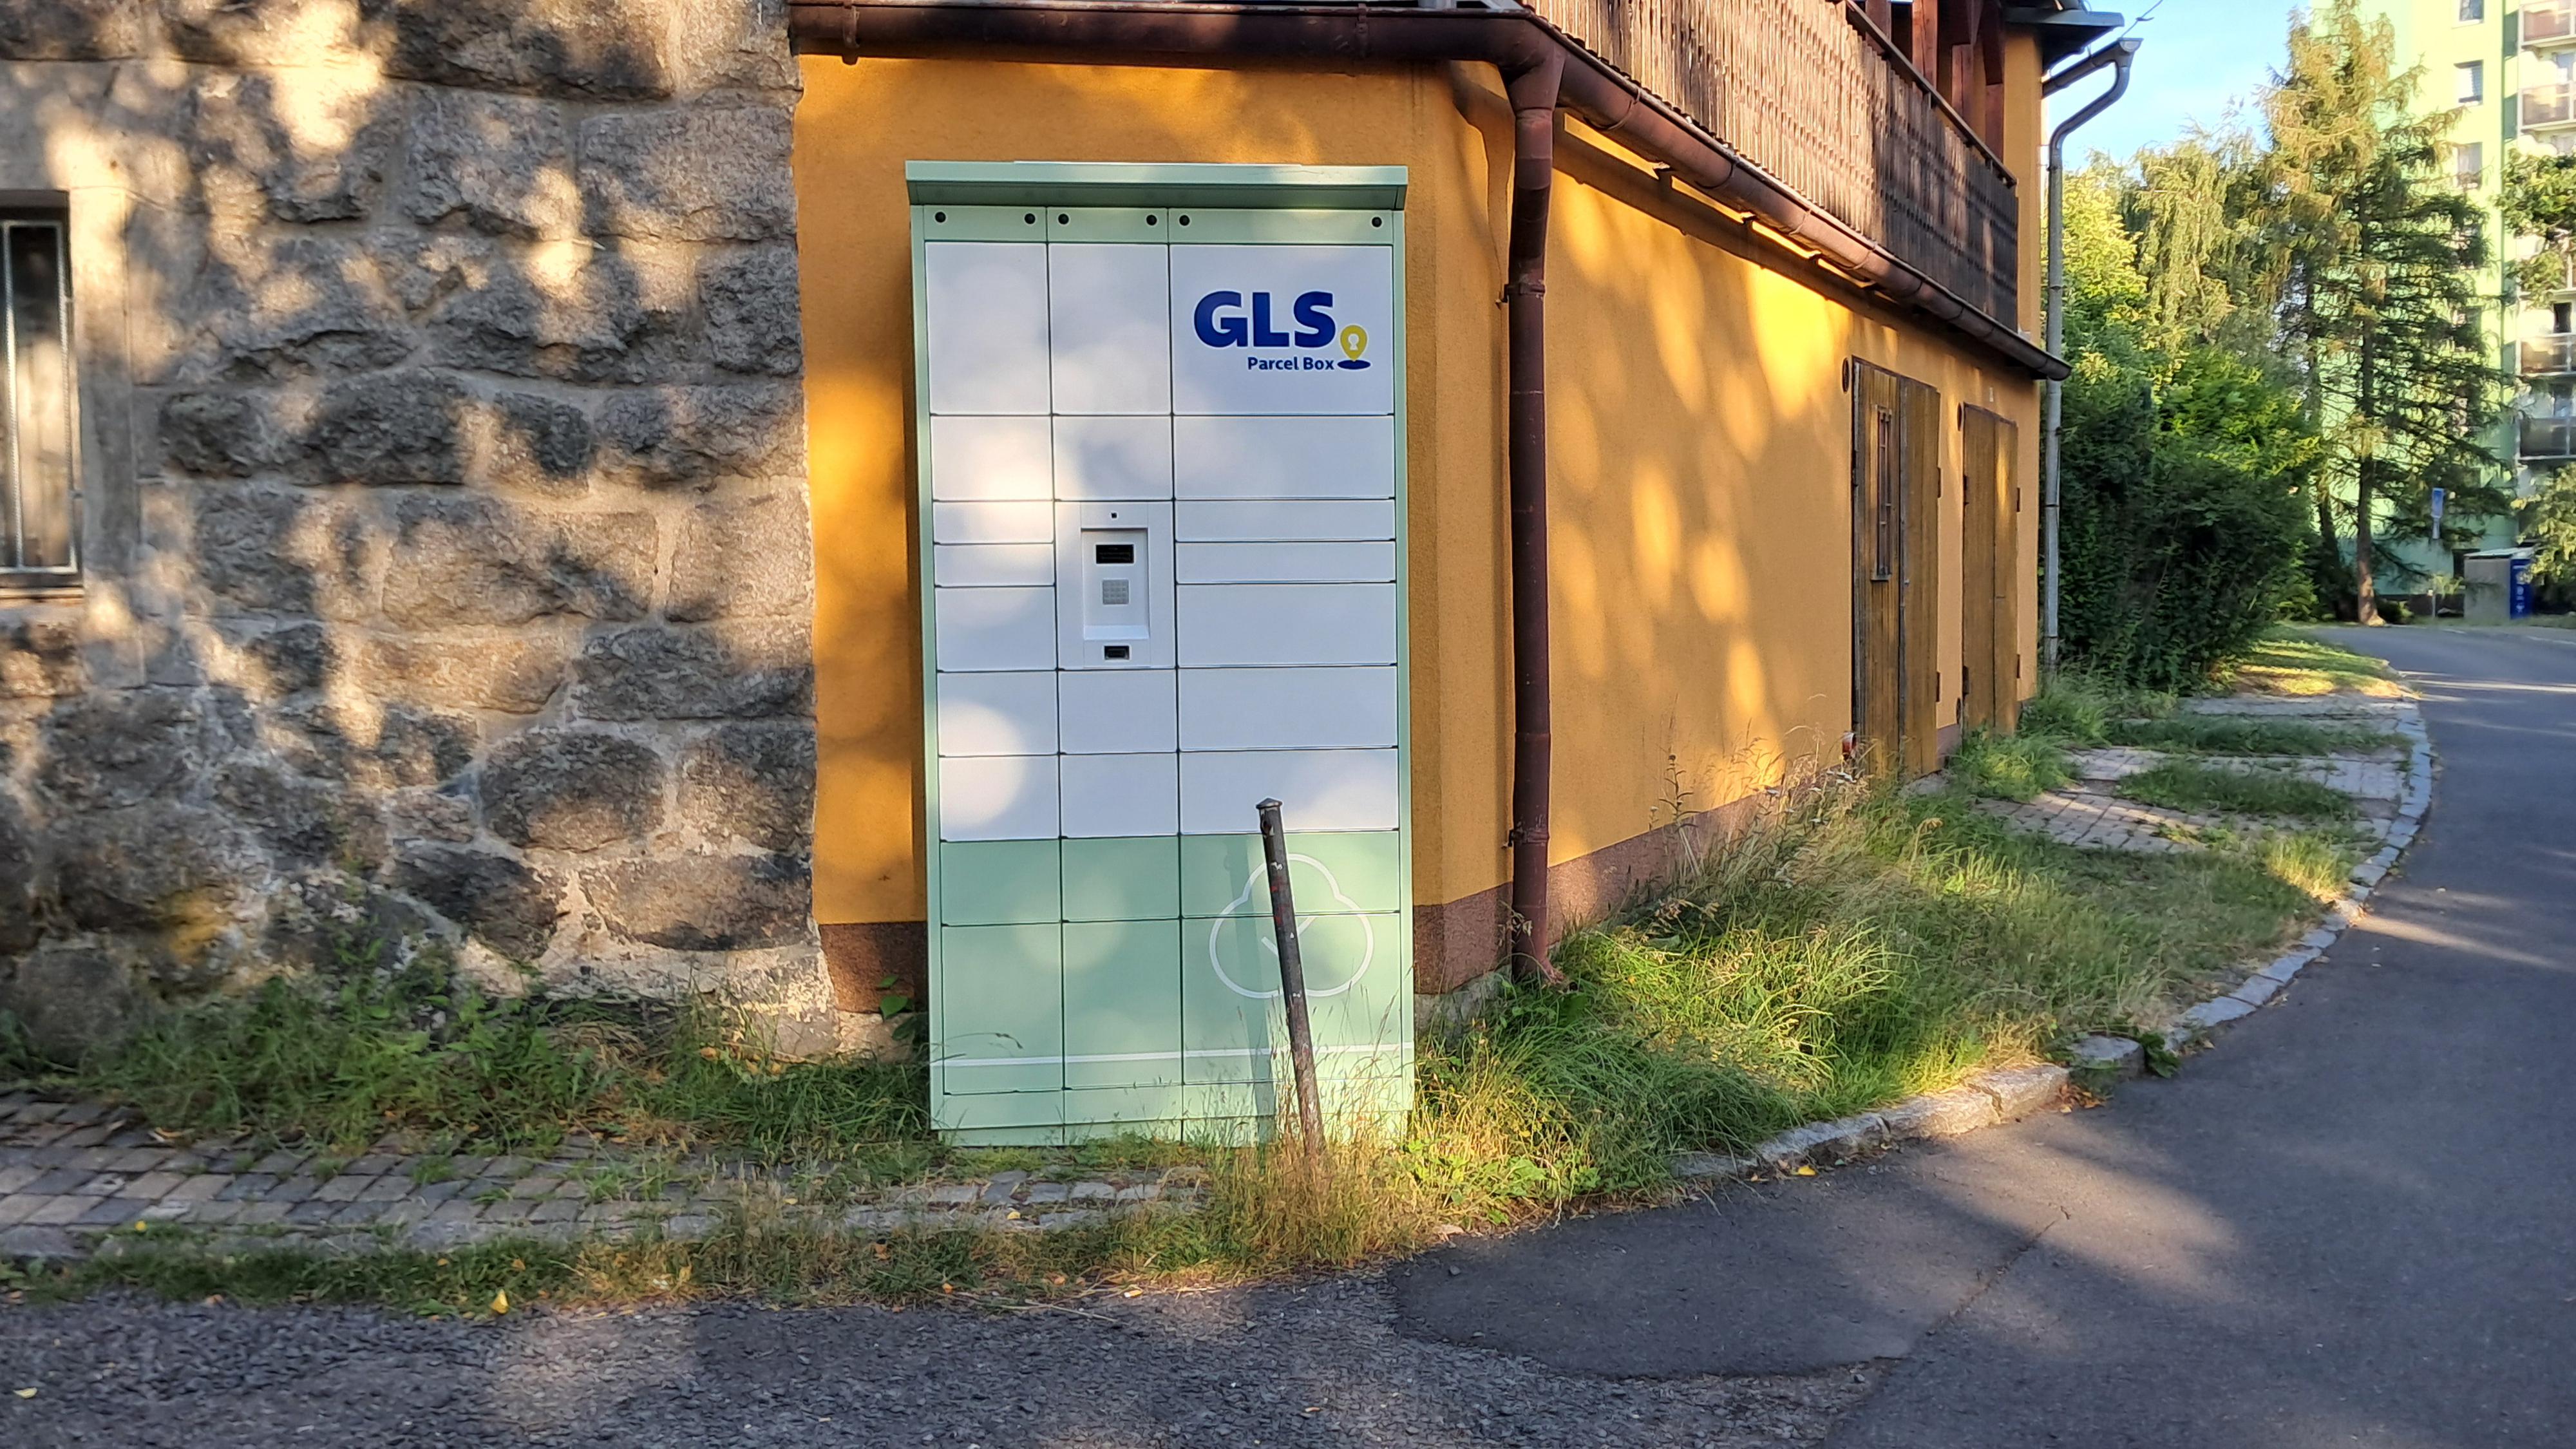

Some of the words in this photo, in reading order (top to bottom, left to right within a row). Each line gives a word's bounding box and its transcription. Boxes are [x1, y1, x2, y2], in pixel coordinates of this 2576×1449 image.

[1193, 290, 1336, 348] GLS
[1247, 356, 1300, 371] Parcel
[1303, 357, 1335, 371] Box
